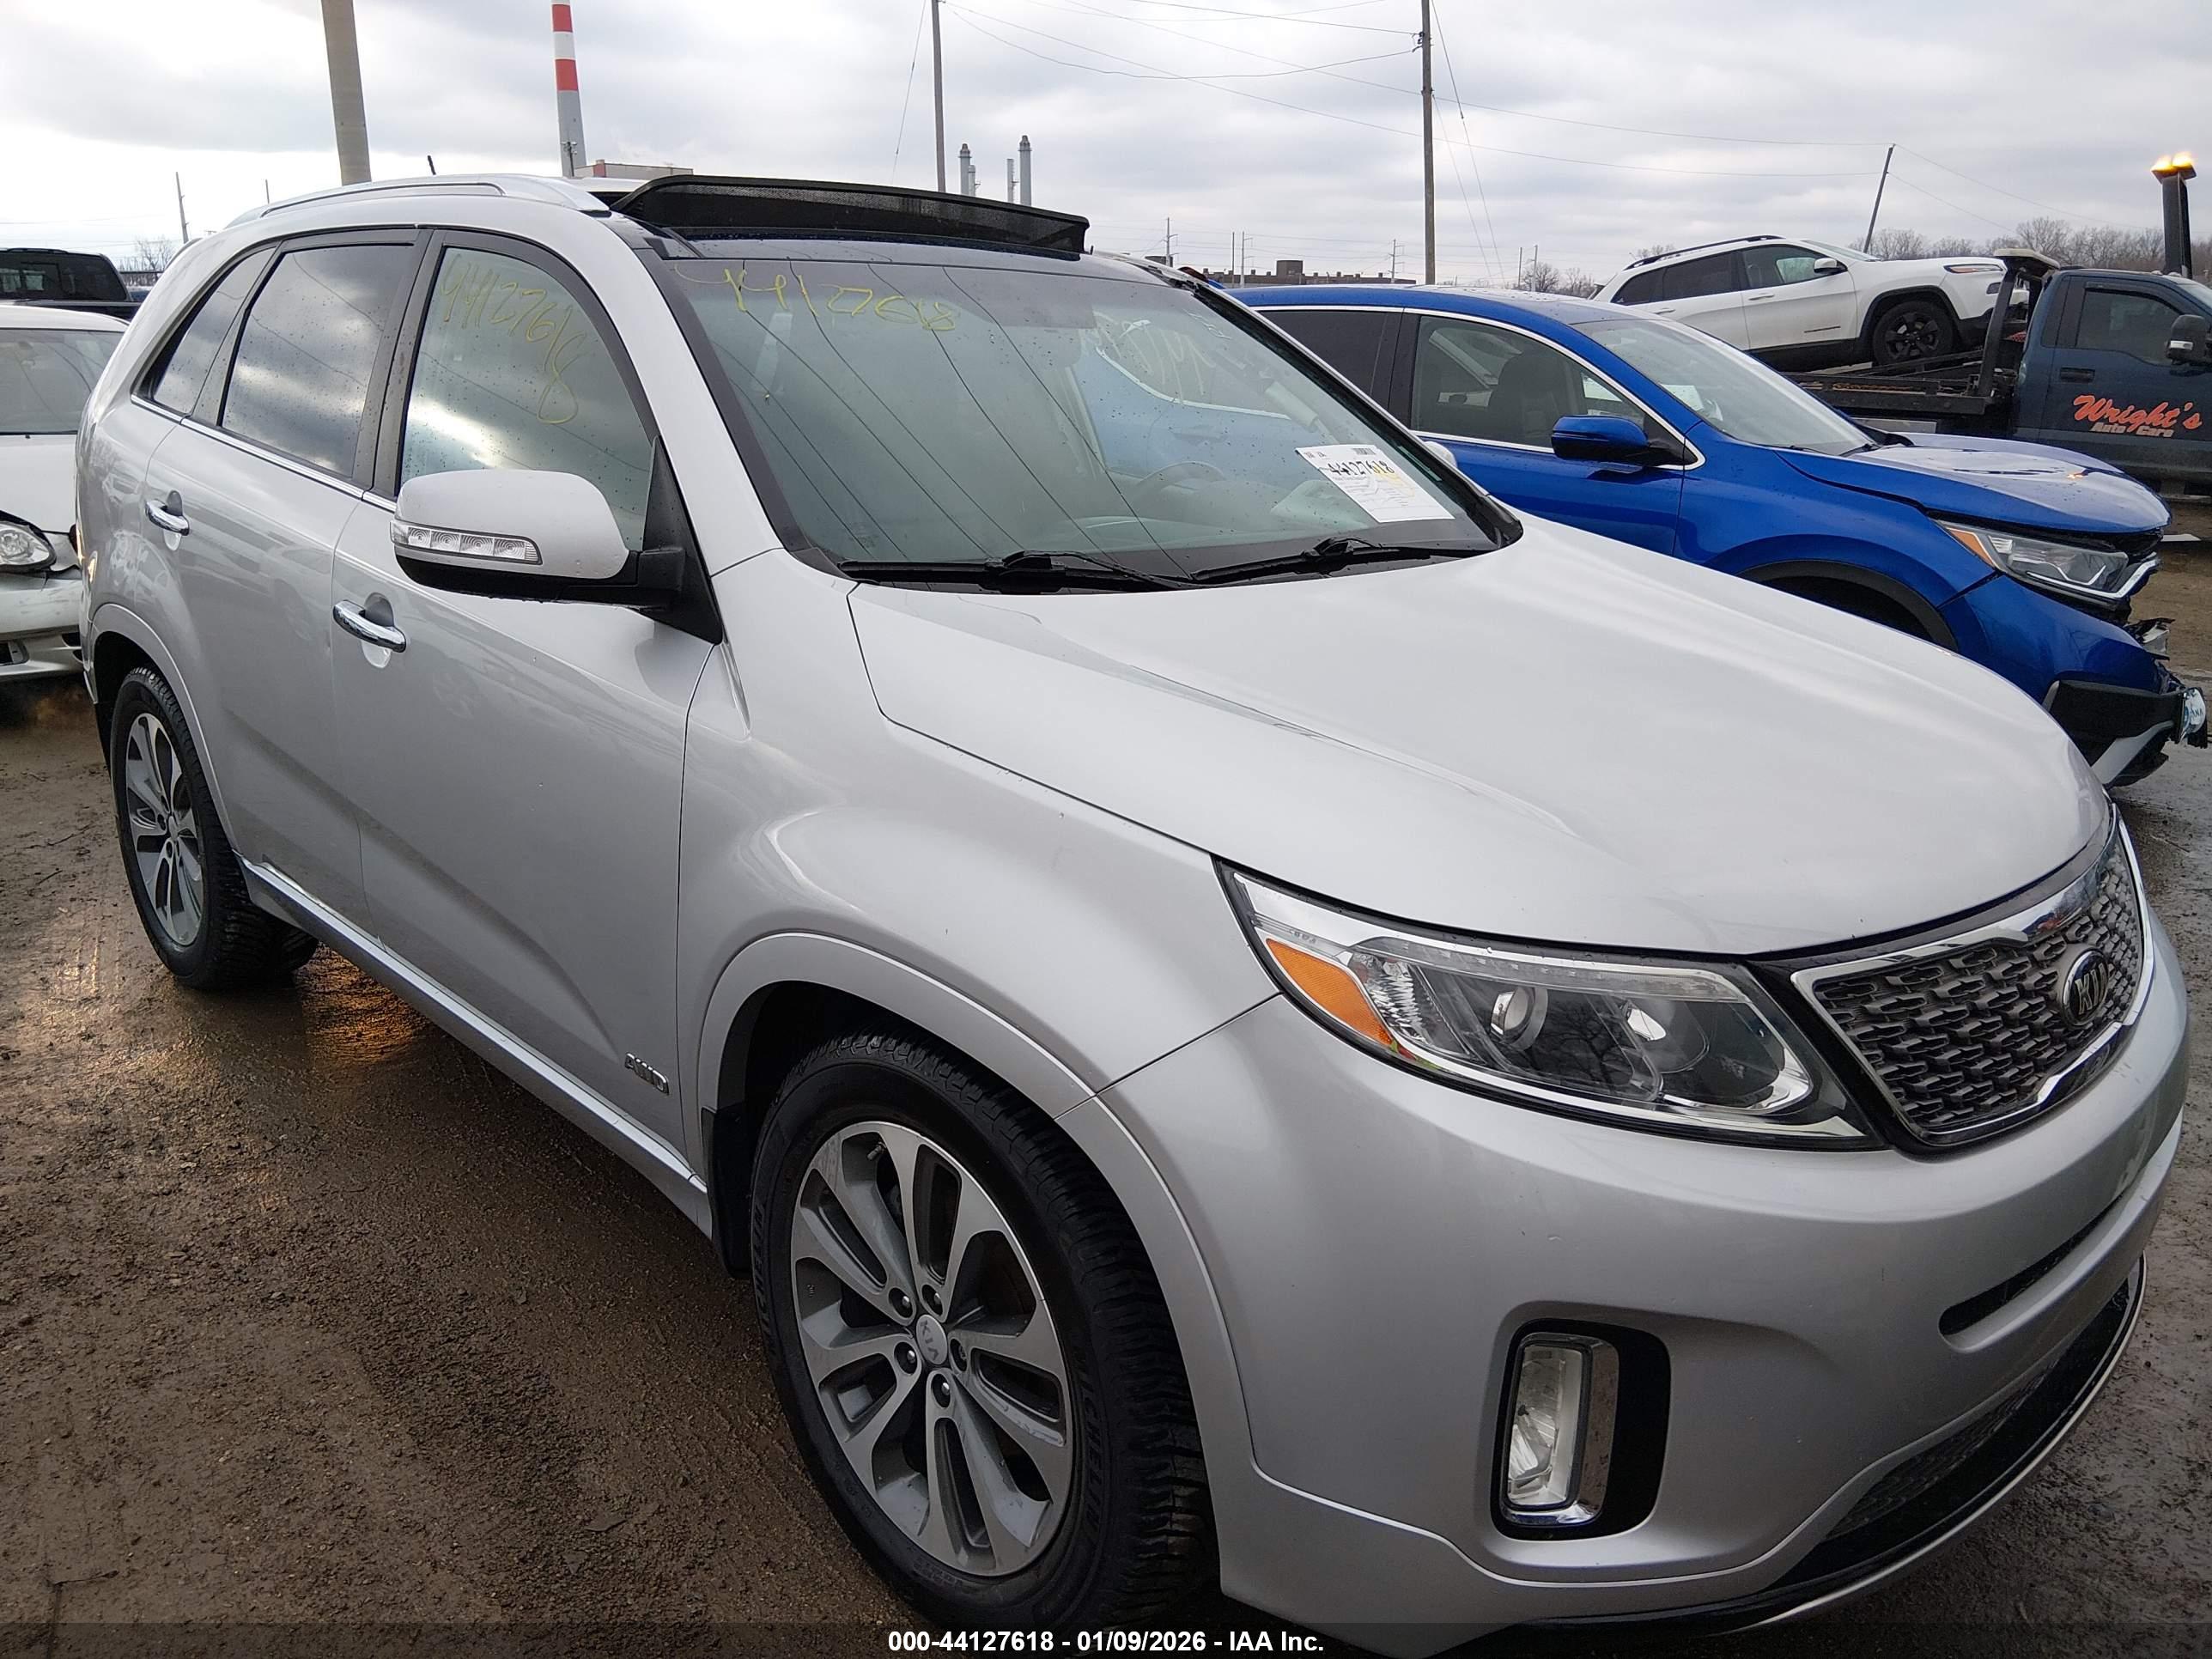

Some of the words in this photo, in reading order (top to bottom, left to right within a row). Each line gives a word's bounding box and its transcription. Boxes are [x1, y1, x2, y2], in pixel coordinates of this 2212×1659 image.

[2073, 394, 2203, 433] Wright's
[2091, 423, 2127, 434] Auto
[2136, 426, 2174, 437] Care
[1327, 459, 1395, 476] 44127618
[920, 1319, 939, 1361] KIA
